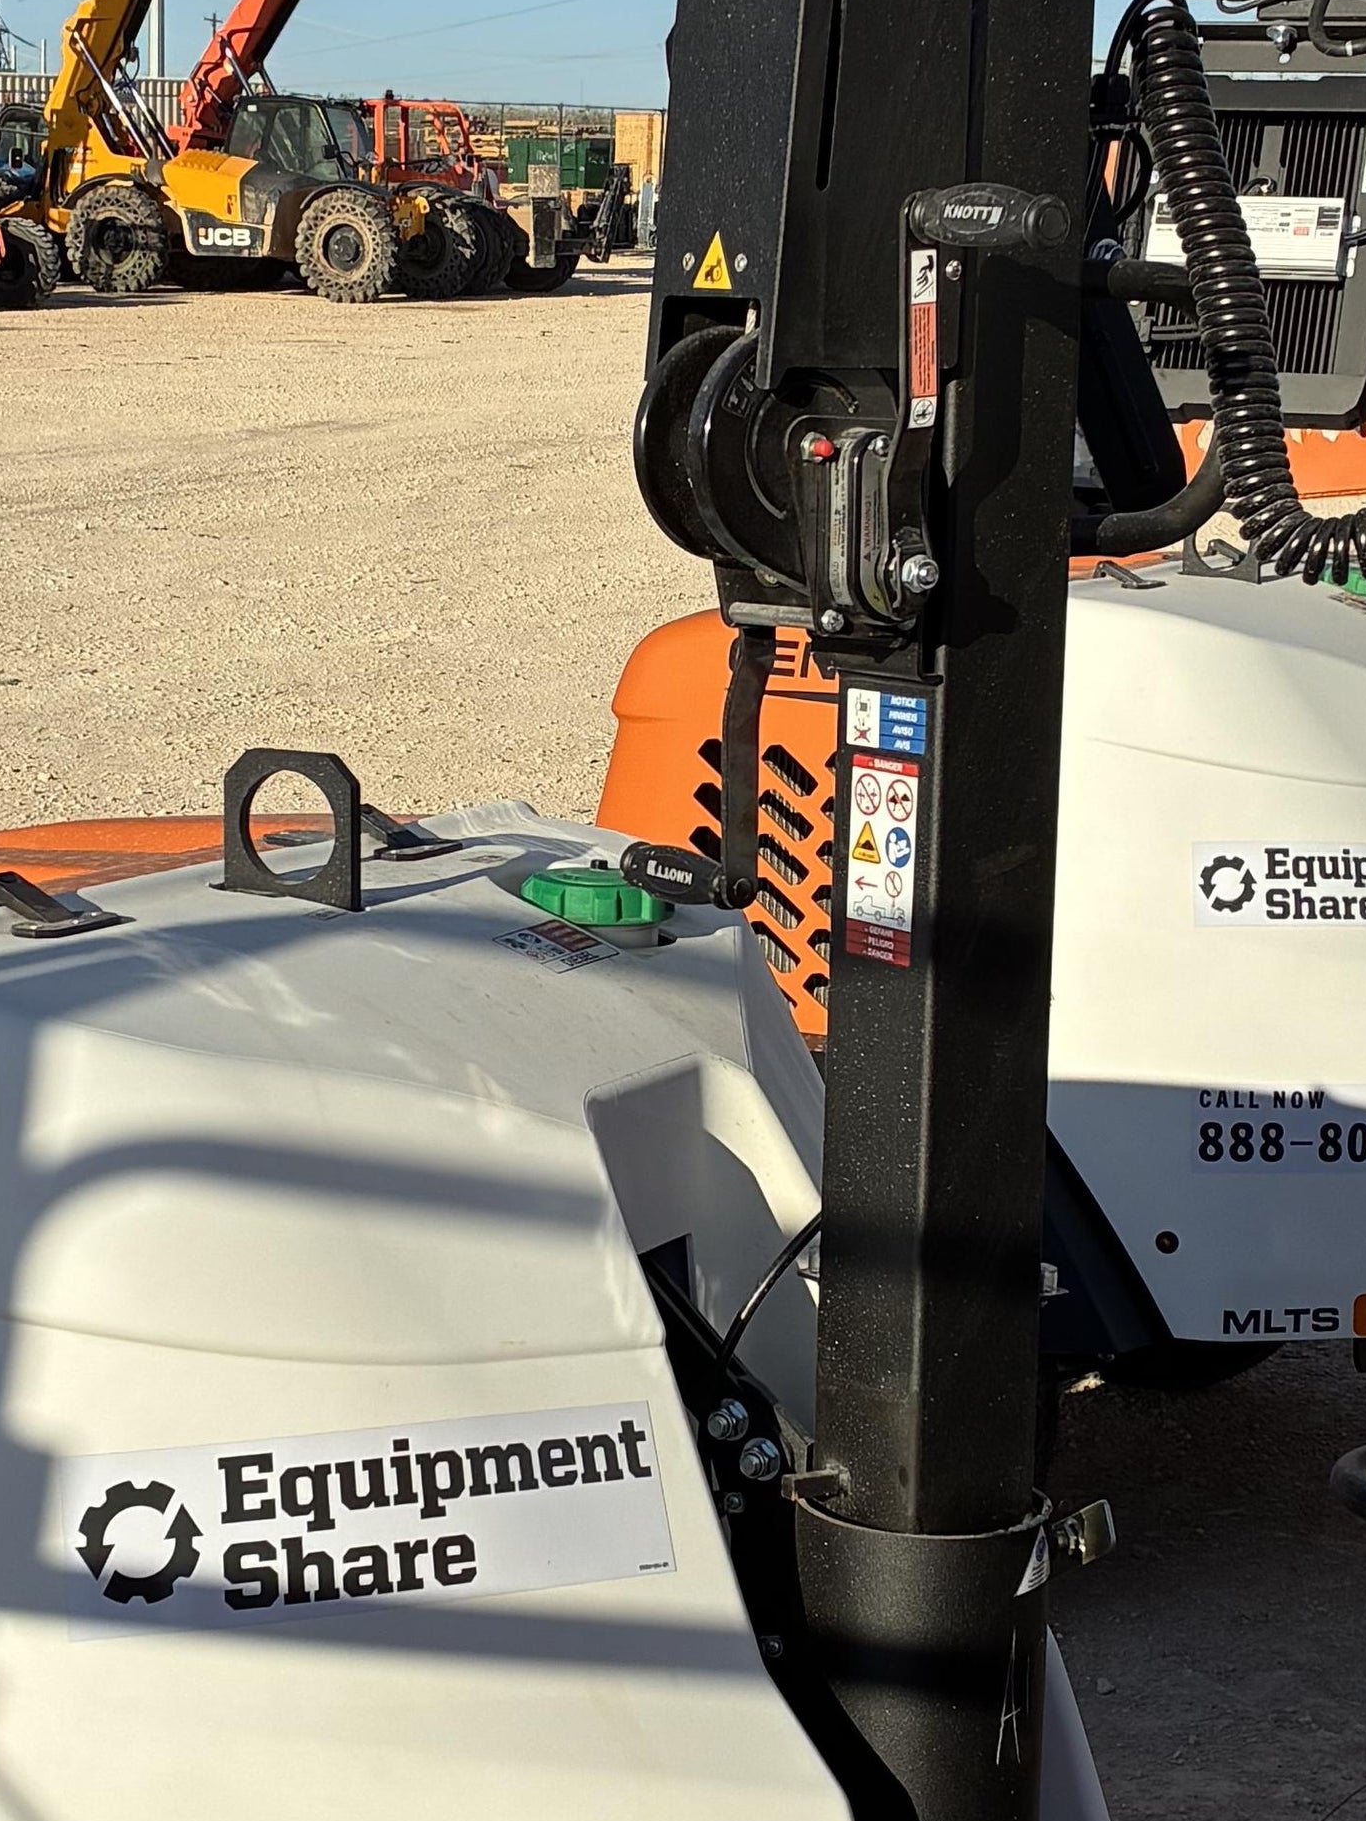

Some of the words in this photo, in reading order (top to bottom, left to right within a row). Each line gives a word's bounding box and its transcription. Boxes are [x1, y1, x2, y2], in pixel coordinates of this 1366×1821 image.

[943, 203, 994, 221] KNOTT
[199, 227, 251, 247] JCB
[1199, 1089, 1260, 1109] CALL
[1273, 1091, 1325, 1110] NOW
[1222, 1307, 1340, 1334] MLTS
[218, 1419, 653, 1532] Equipment
[222, 1533, 478, 1611] Share
